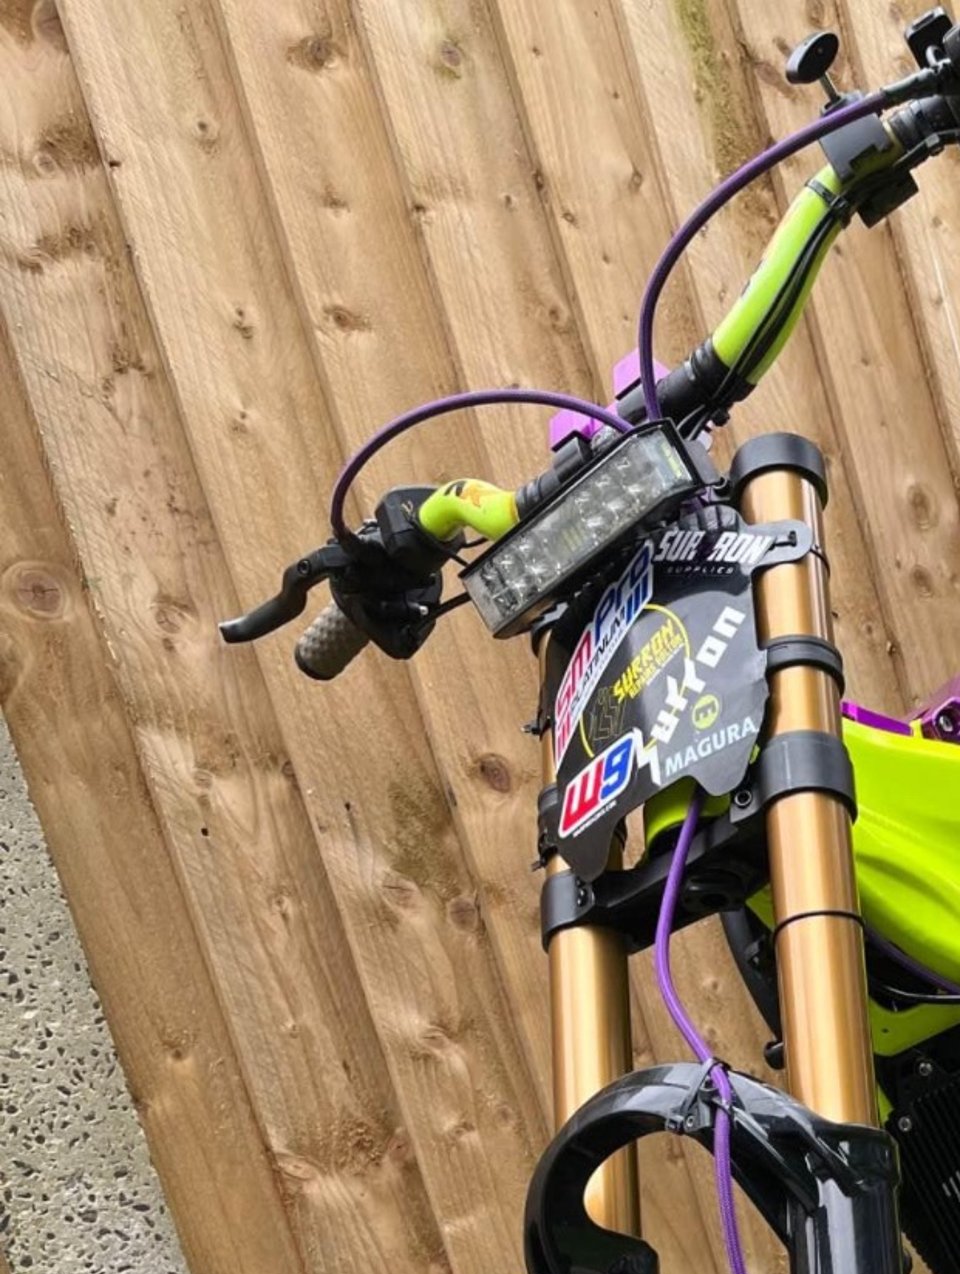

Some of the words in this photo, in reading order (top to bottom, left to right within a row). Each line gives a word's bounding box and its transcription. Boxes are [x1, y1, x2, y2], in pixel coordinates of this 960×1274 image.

[653, 528, 706, 561] SUR
[707, 530, 775, 564] RON
[611, 616, 677, 704] SURRON
[664, 716, 759, 777] MAGURA
[562, 736, 634, 832] W9
